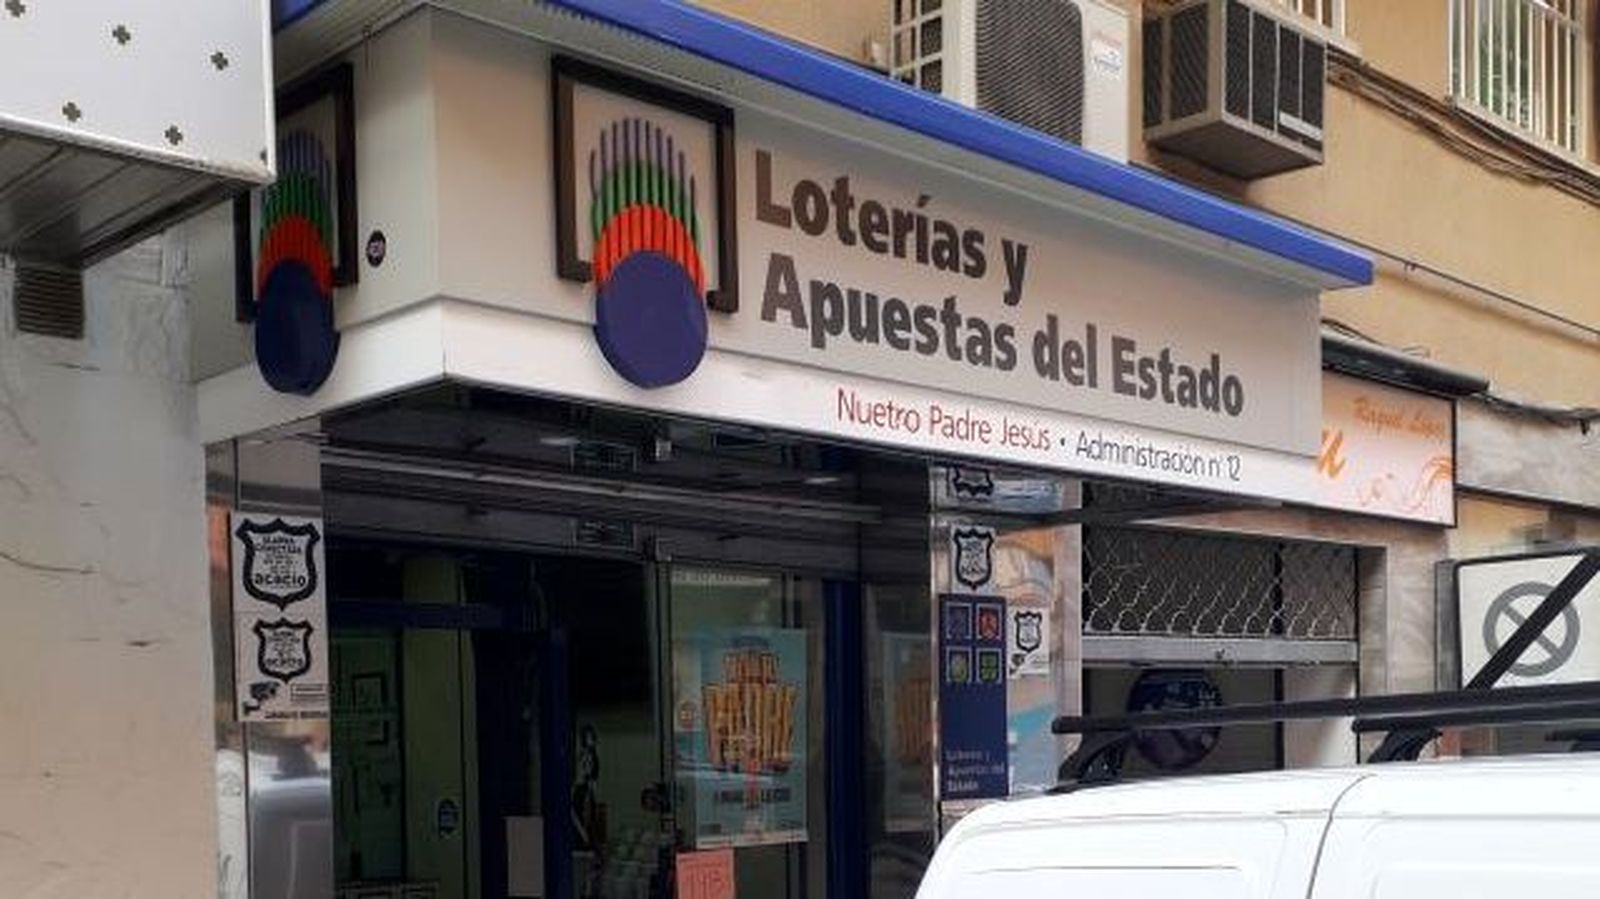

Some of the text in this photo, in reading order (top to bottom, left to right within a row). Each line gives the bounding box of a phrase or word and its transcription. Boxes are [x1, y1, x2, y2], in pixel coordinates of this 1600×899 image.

[755, 149, 1029, 306] Loterías y
[760, 252, 1245, 417] Apuestas del Estado
[837, 387, 921, 434] Nuetro
[929, 404, 993, 445] Padre
[1226, 455, 1241, 482] 12
